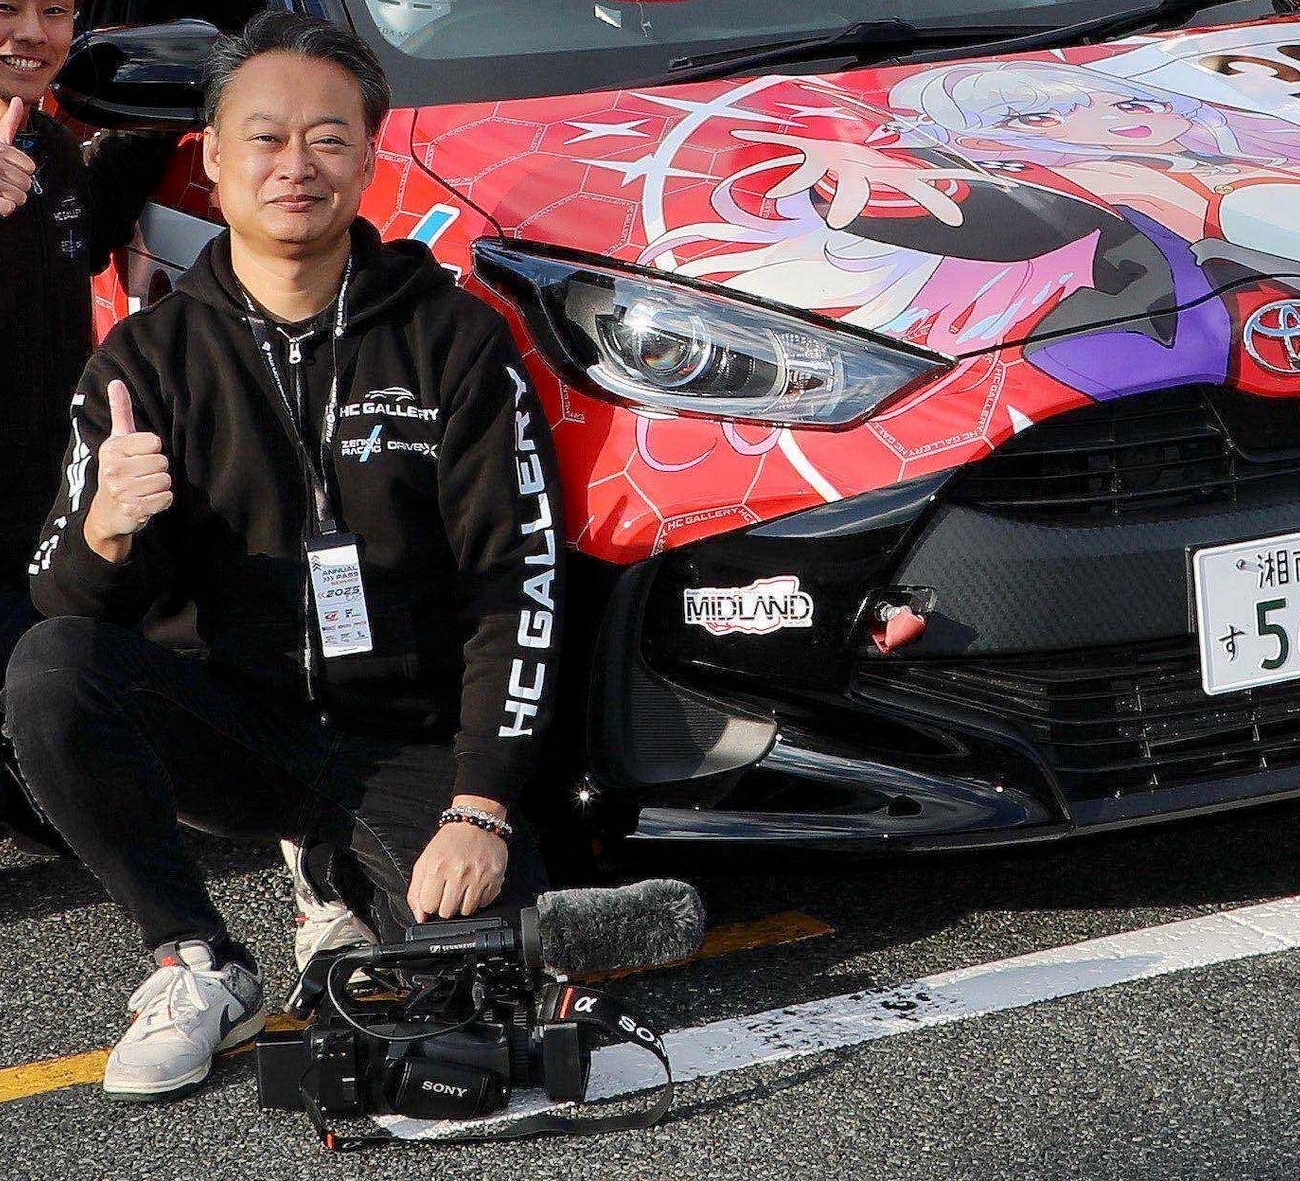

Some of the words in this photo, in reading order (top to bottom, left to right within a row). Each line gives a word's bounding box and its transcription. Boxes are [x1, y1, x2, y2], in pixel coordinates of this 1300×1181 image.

[340, 403, 361, 418] HC
[362, 402, 440, 421] GALLERY
[504, 365, 557, 650] GALLERY
[1218, 624, 1245, 663] す
[498, 657, 546, 738] HC
[421, 1080, 468, 1098] SONY
